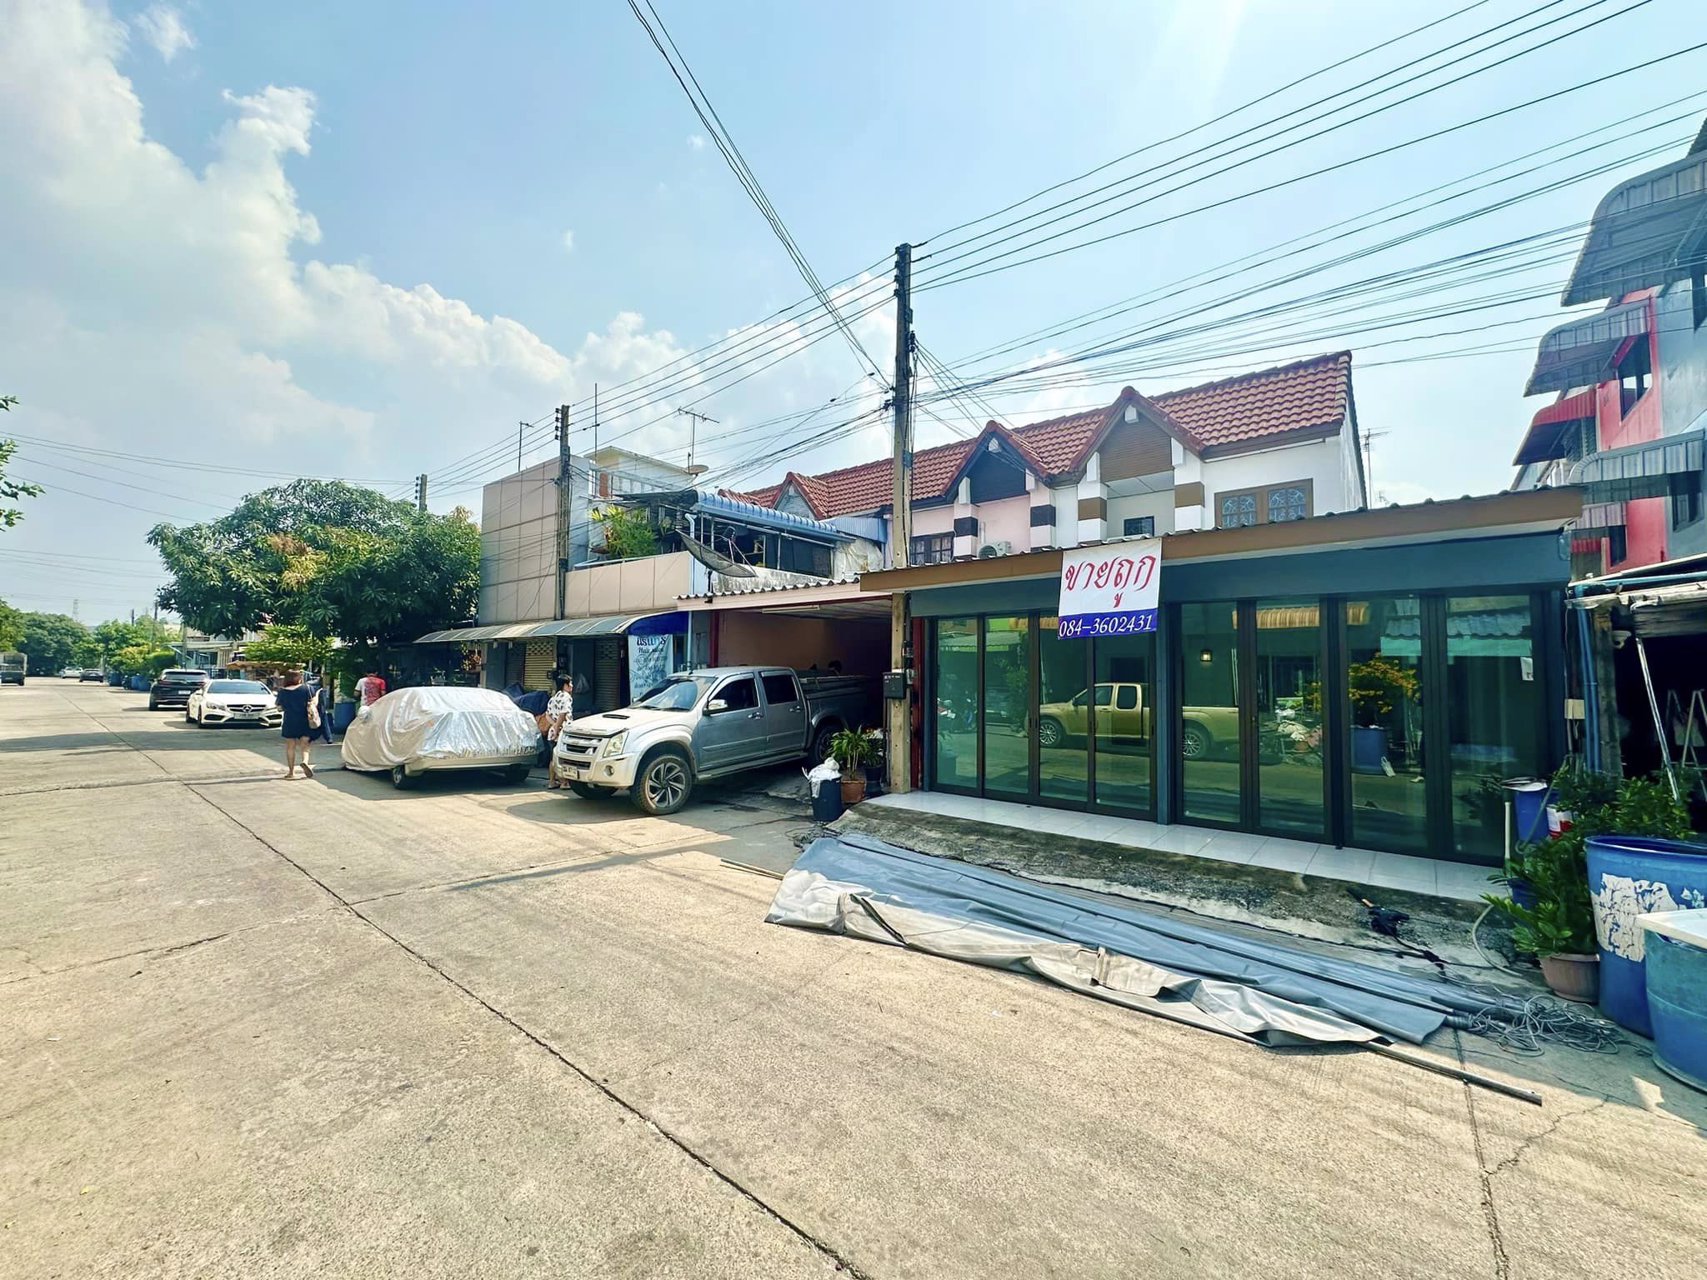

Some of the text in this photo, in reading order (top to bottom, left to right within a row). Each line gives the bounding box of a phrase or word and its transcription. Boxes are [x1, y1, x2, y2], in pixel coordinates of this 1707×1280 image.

[1065, 555, 1156, 608] ขายถูก
[1059, 614, 1153, 637] 084-3602431
